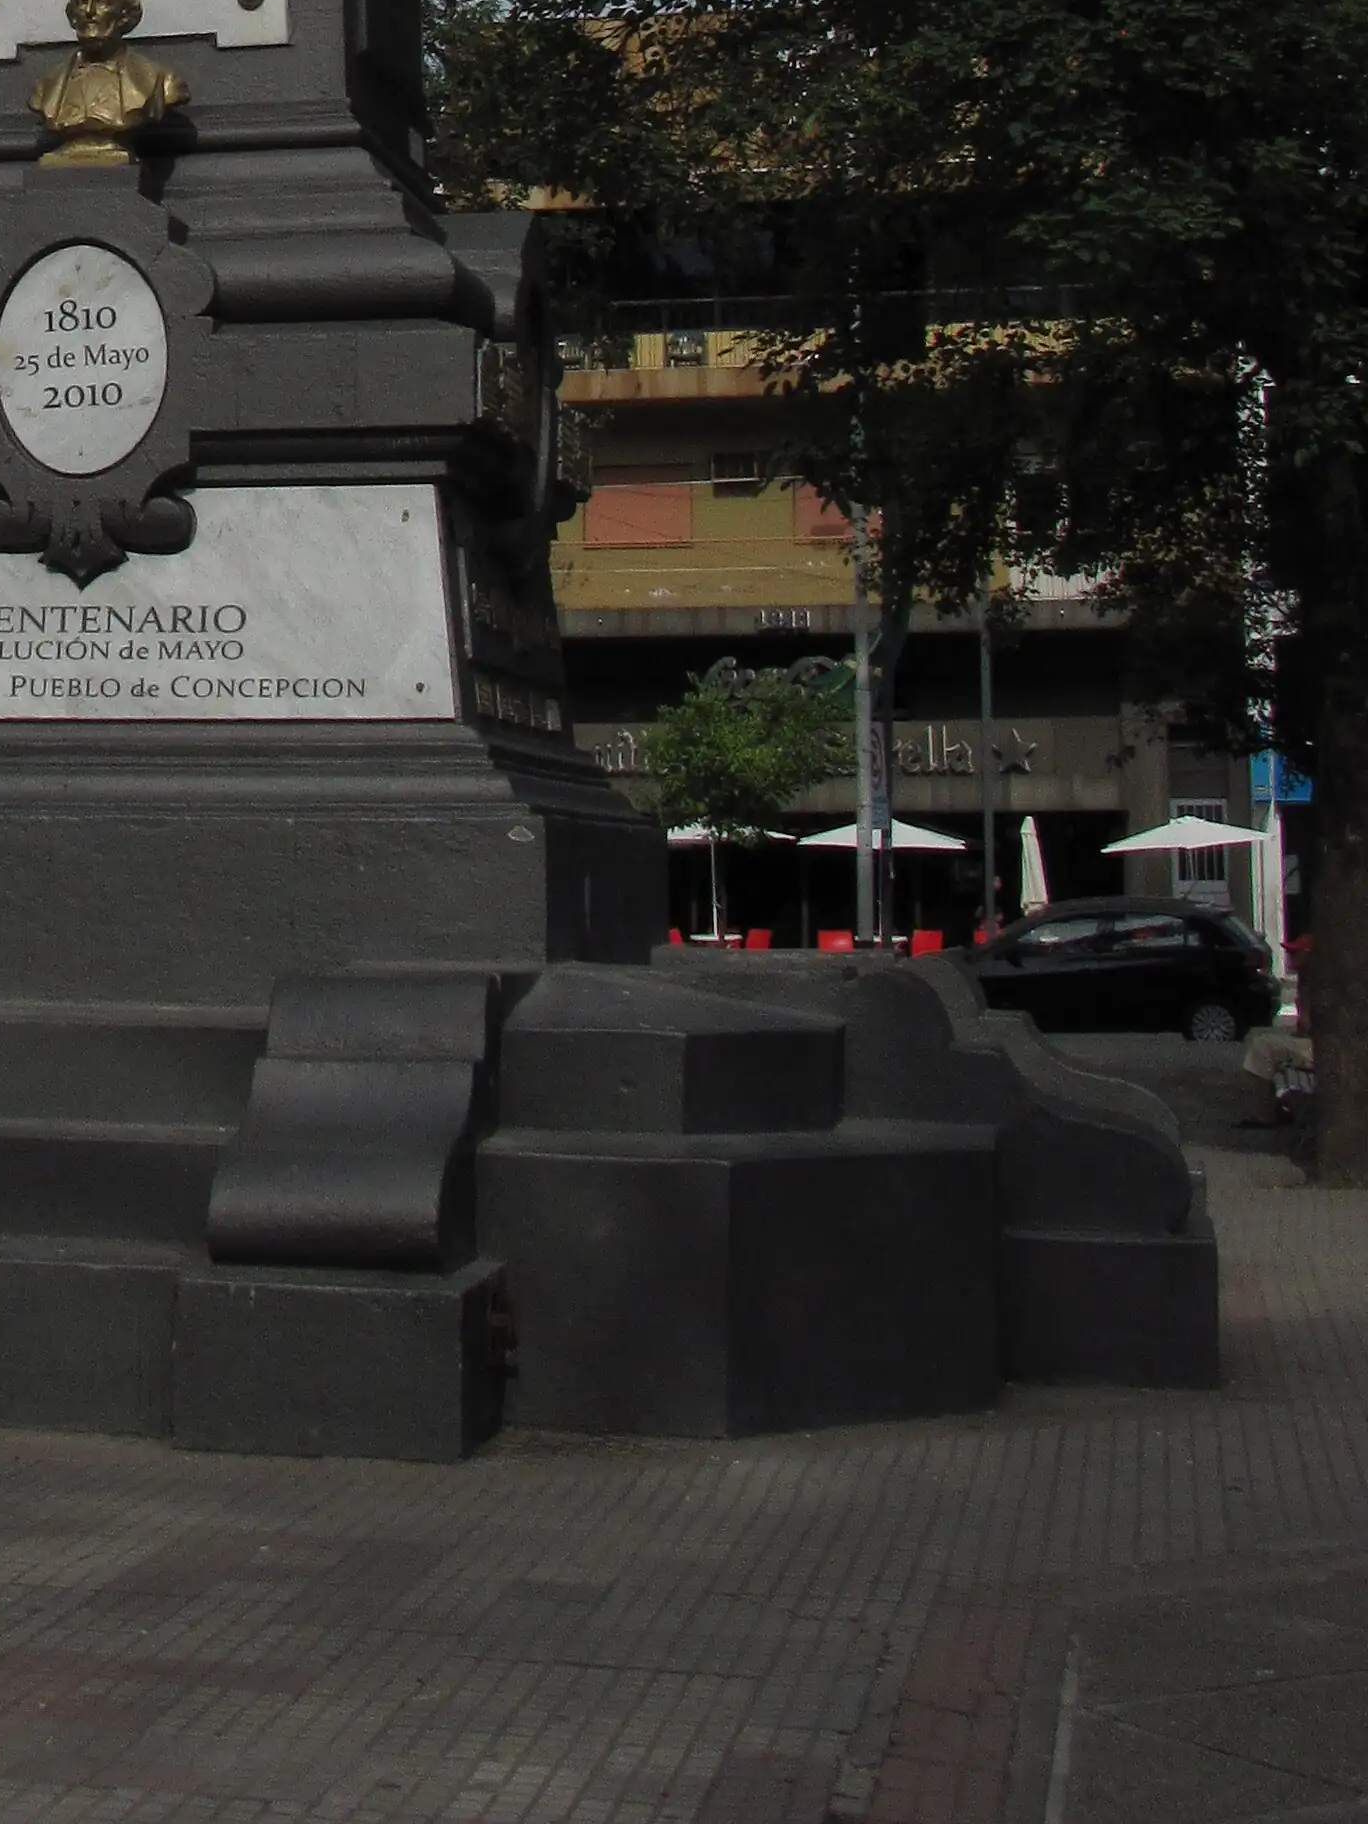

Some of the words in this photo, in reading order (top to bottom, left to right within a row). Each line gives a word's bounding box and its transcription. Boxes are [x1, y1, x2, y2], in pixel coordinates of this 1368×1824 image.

[44, 300, 116, 332] 1810
[14, 354, 39, 376] 25
[47, 346, 75, 369] de
[84, 343, 149, 371] Mayo
[43, 382, 123, 409] 2010
[119, 640, 149, 660] de
[158, 640, 244, 660] MAYO
[10, 674, 120, 698] PUEBLO
[130, 677, 160, 698] de
[171, 675, 366, 698] CONCEPCION
